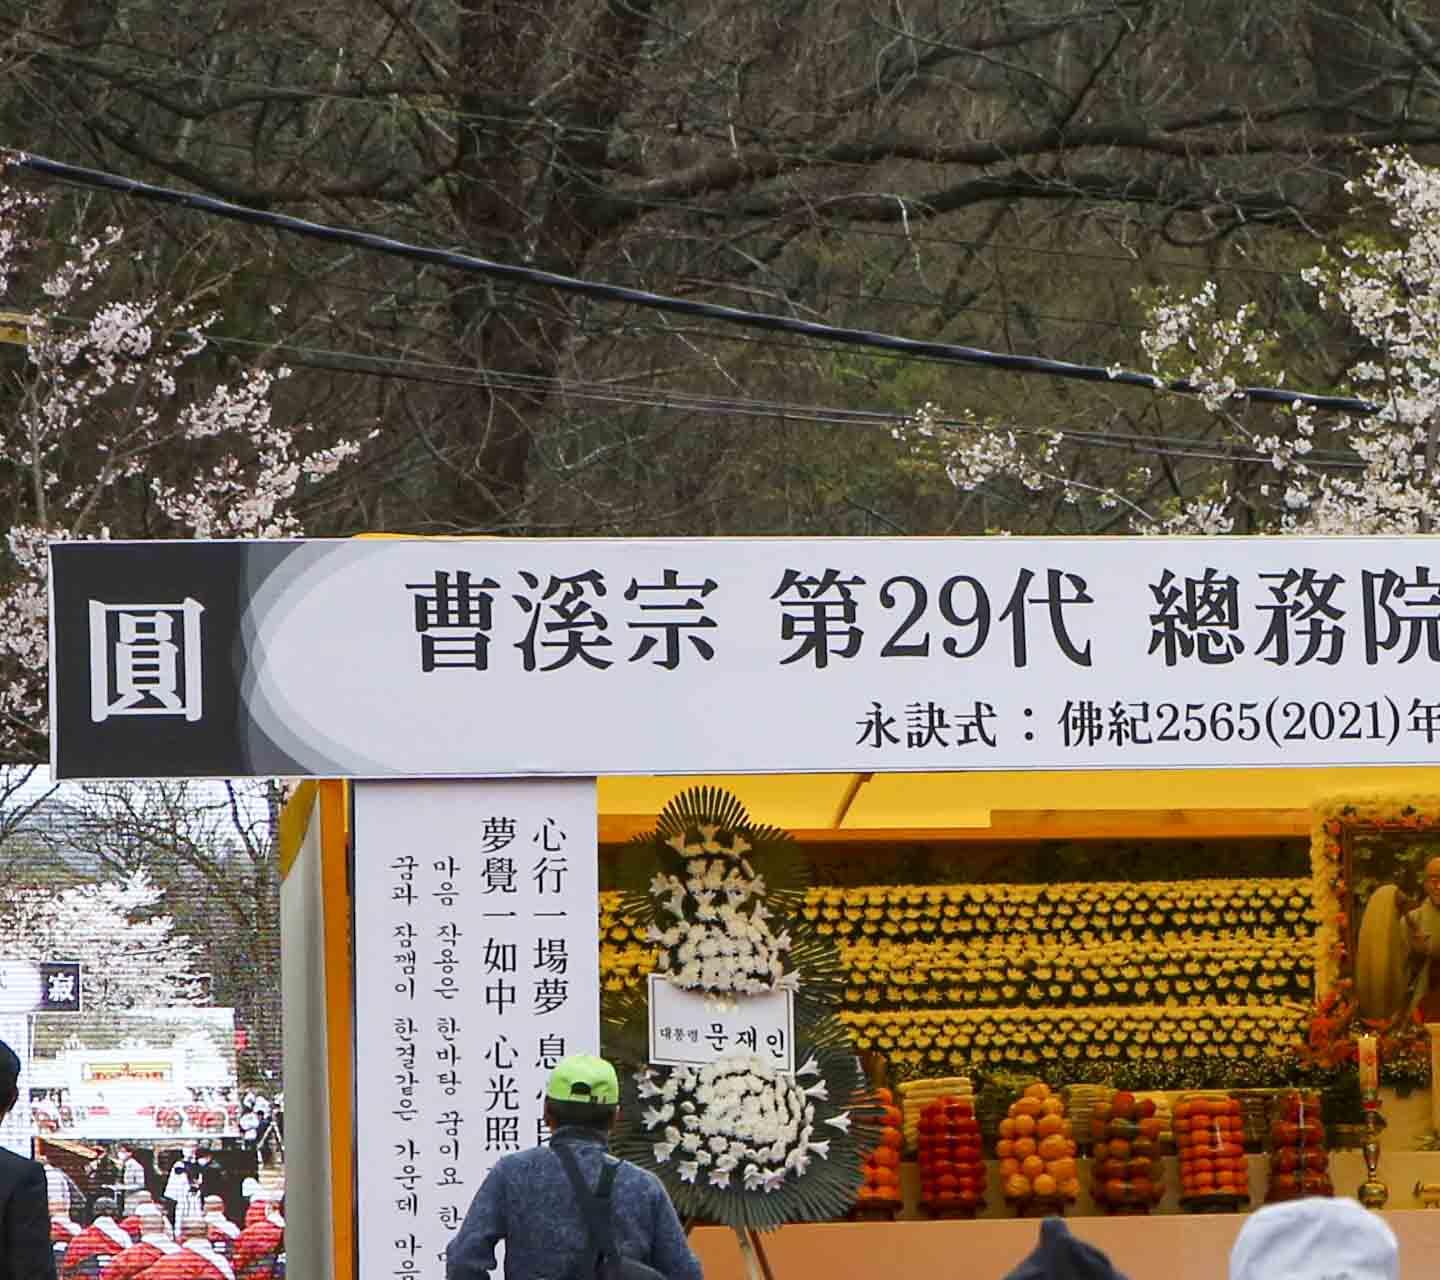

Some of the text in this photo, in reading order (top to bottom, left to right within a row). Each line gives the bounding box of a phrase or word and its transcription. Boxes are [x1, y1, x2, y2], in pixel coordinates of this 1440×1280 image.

[404, 568, 719, 673] 曹溪宗
[769, 567, 1095, 669] 第29代
[88, 596, 206, 723] 圓
[855, 701, 998, 749] 永訣式
[390, 855, 419, 906] 꿈과
[432, 855, 461, 906] 마음
[532, 817, 569, 1016] 心行一場夢
[433, 922, 463, 1000] 작용은
[480, 816, 520, 1152] 夢覺一如中 心光照
[392, 1017, 420, 1122] 한결같은
[435, 1017, 462, 1096] 한바탕
[394, 1139, 422, 1217] 가운데
[435, 1110, 465, 1186] 꿈이요
